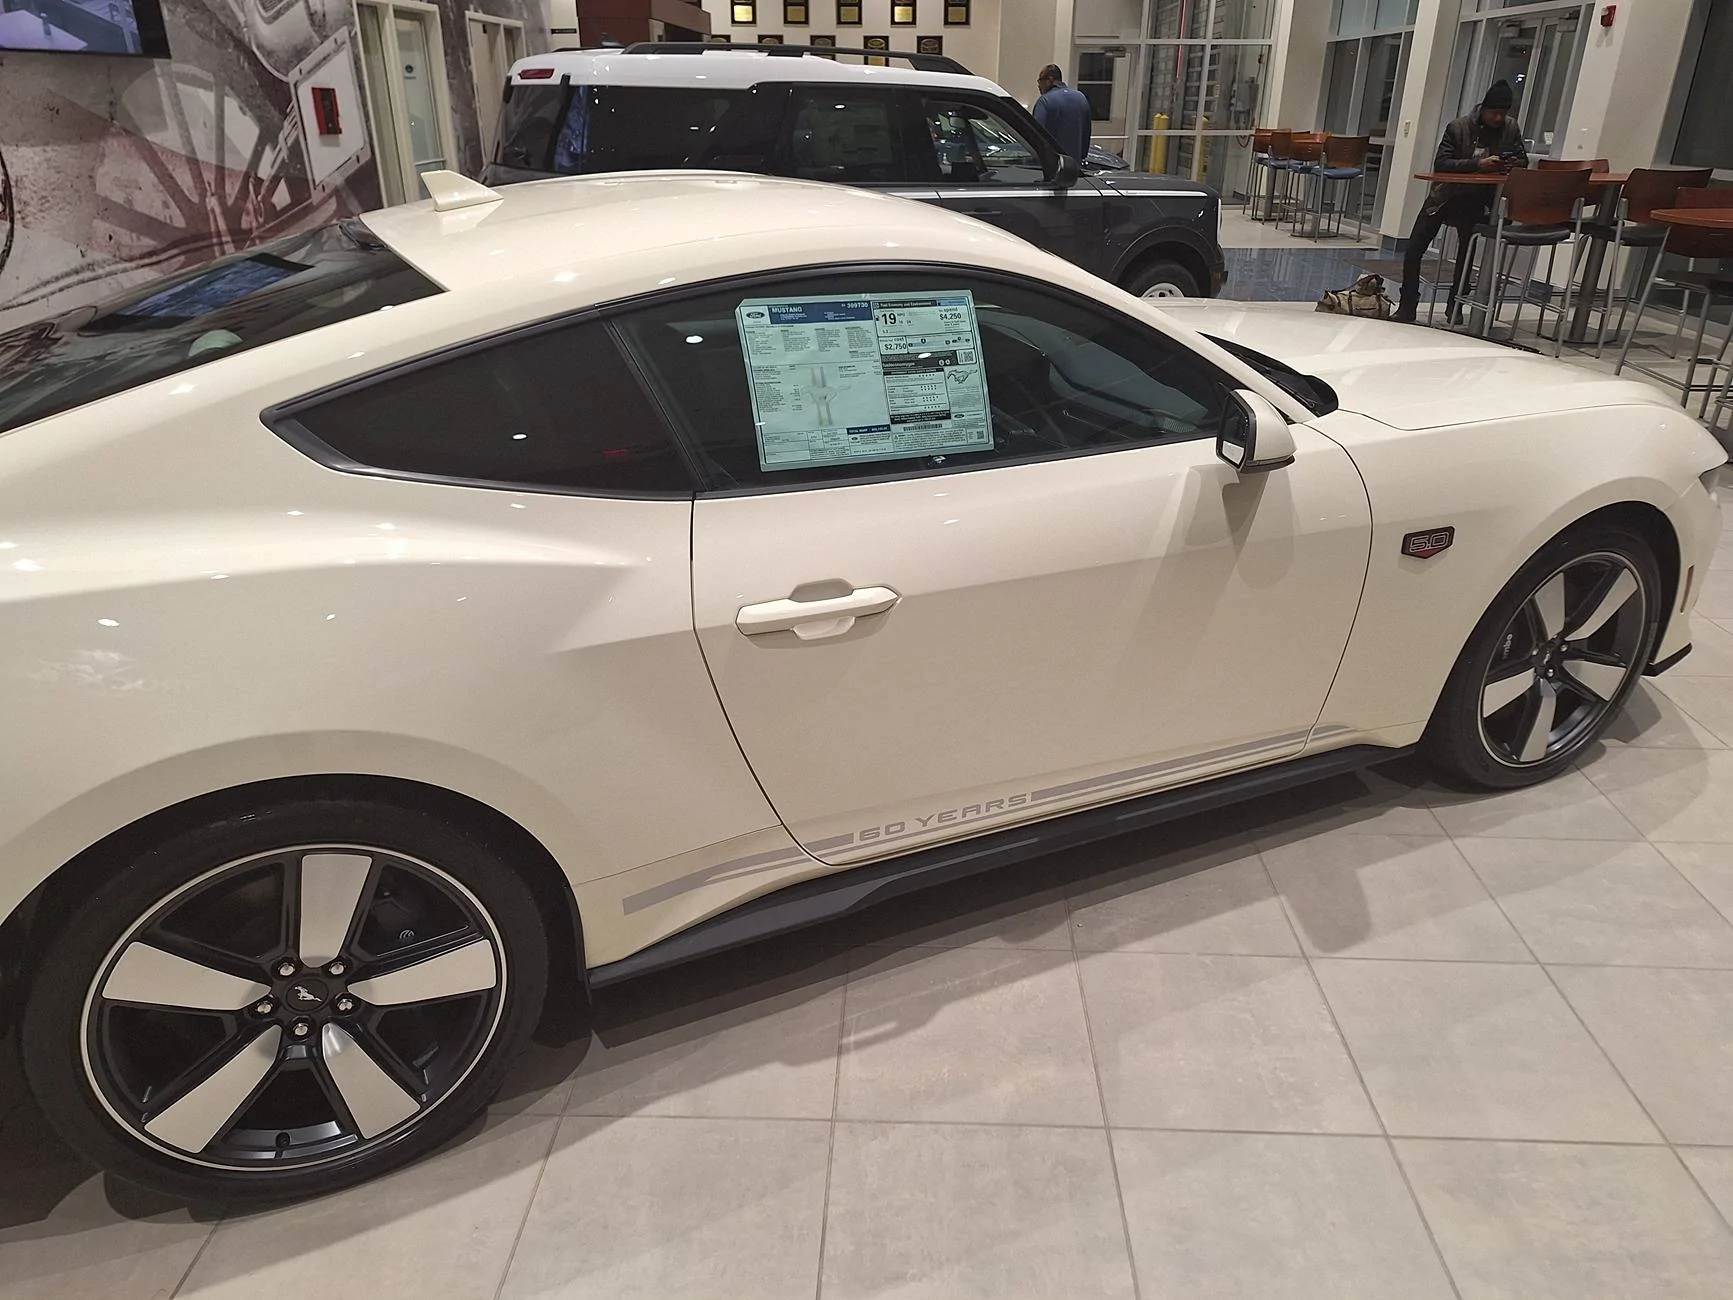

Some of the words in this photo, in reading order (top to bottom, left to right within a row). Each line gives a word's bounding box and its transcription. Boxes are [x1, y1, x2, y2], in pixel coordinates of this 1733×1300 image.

[881, 312, 897, 325] 19
[940, 312, 962, 320] $4,250
[884, 343, 907, 351] $2,750
[1410, 532, 1450, 552] 5.0
[859, 821, 906, 842] 60
[914, 793, 1027, 828] YEARS
